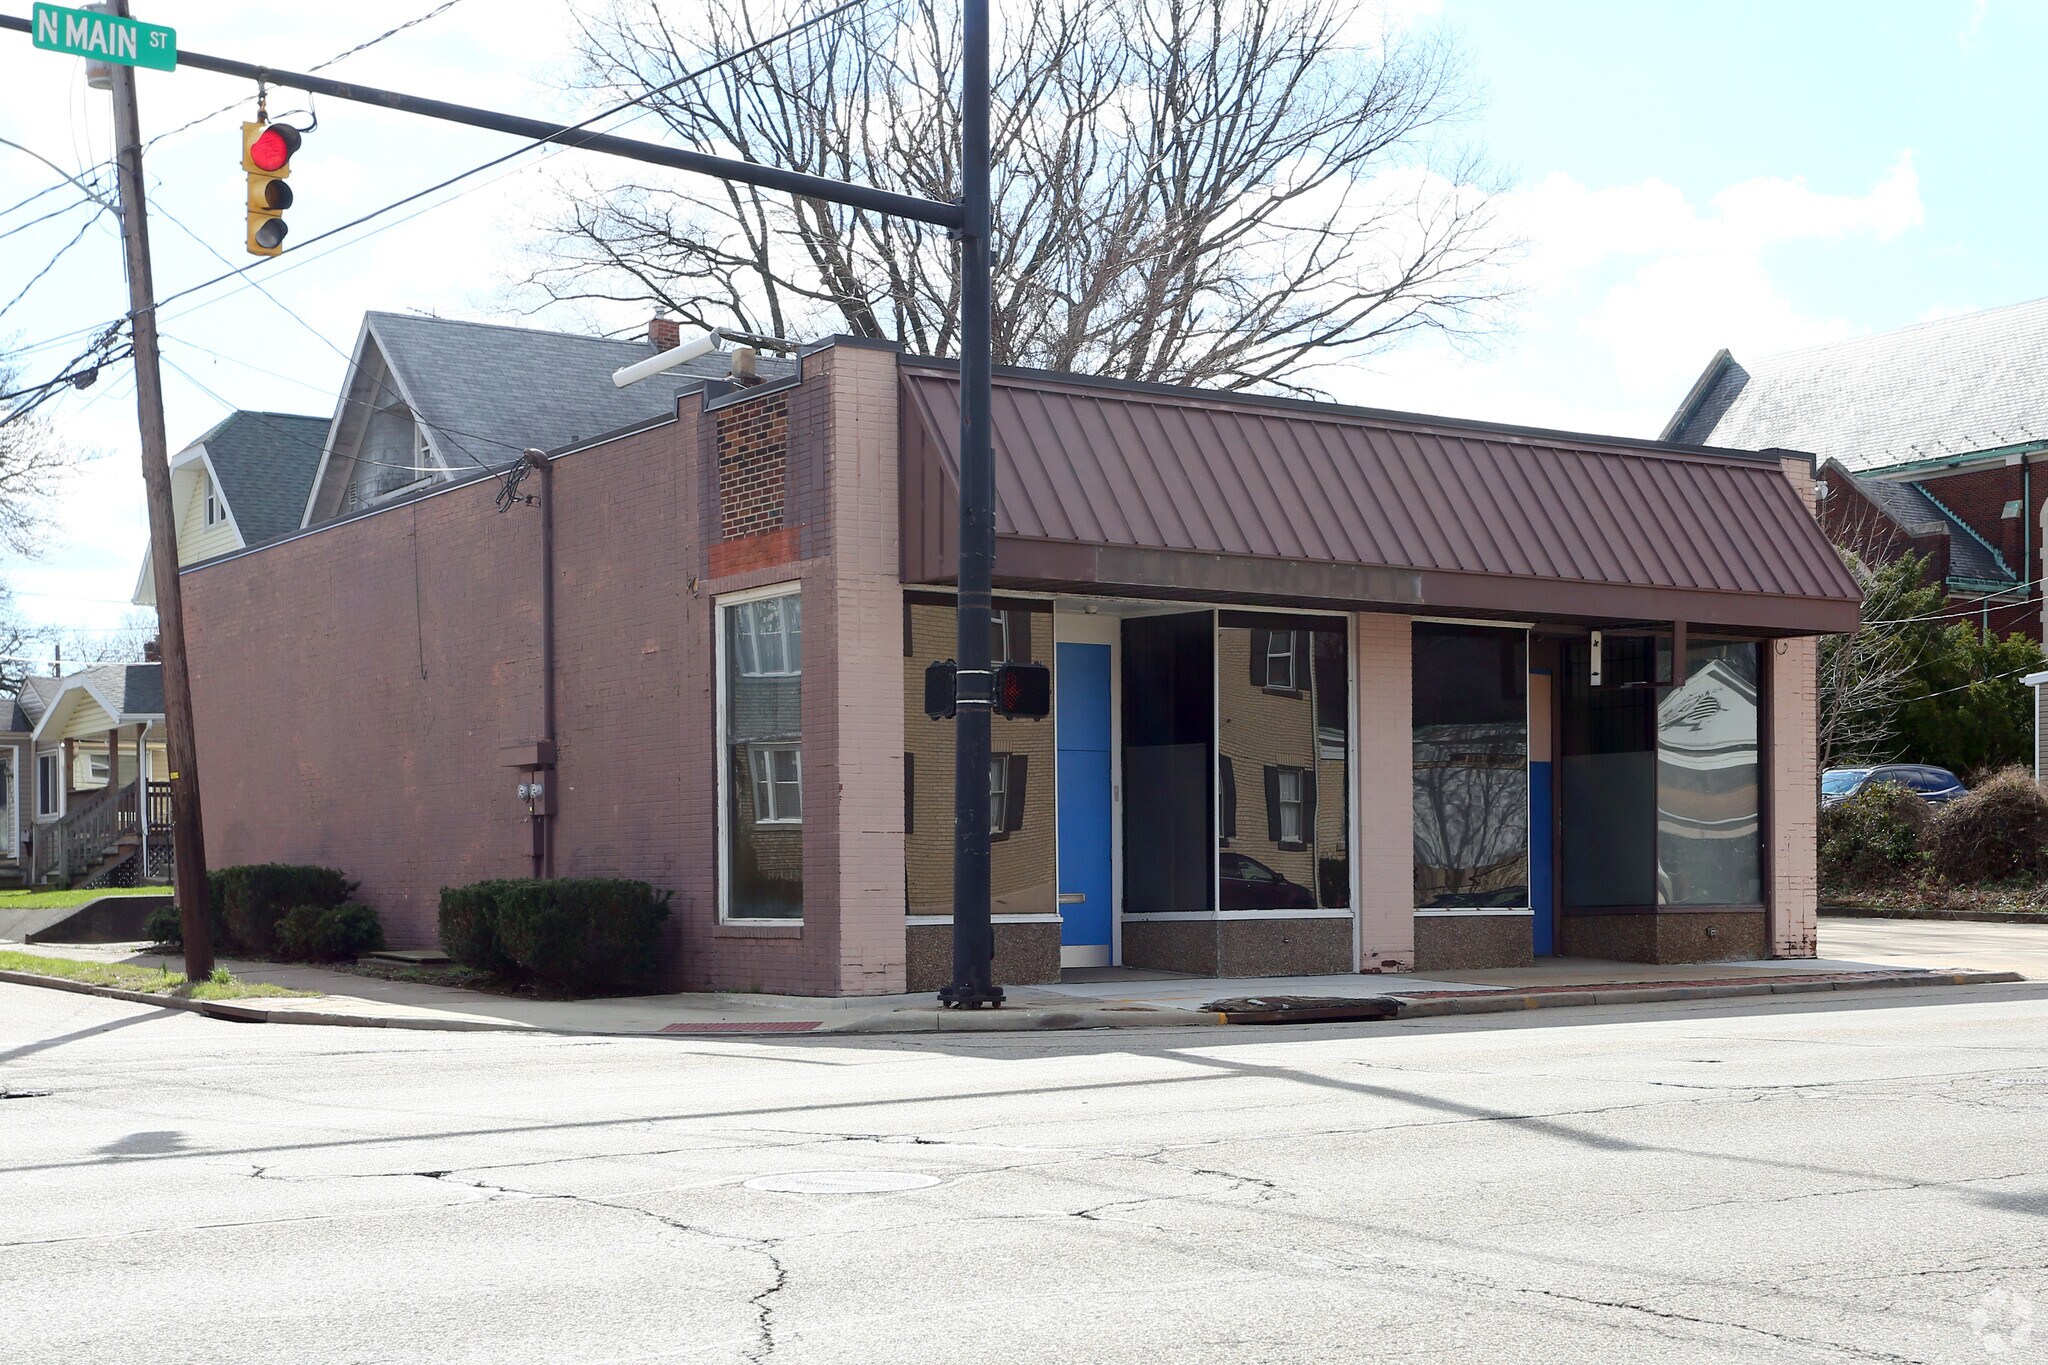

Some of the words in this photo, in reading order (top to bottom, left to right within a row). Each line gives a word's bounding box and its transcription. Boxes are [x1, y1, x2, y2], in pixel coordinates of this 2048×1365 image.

[38, 8, 58, 45] N
[65, 14, 137, 59] MAIN
[149, 31, 168, 49] ST
